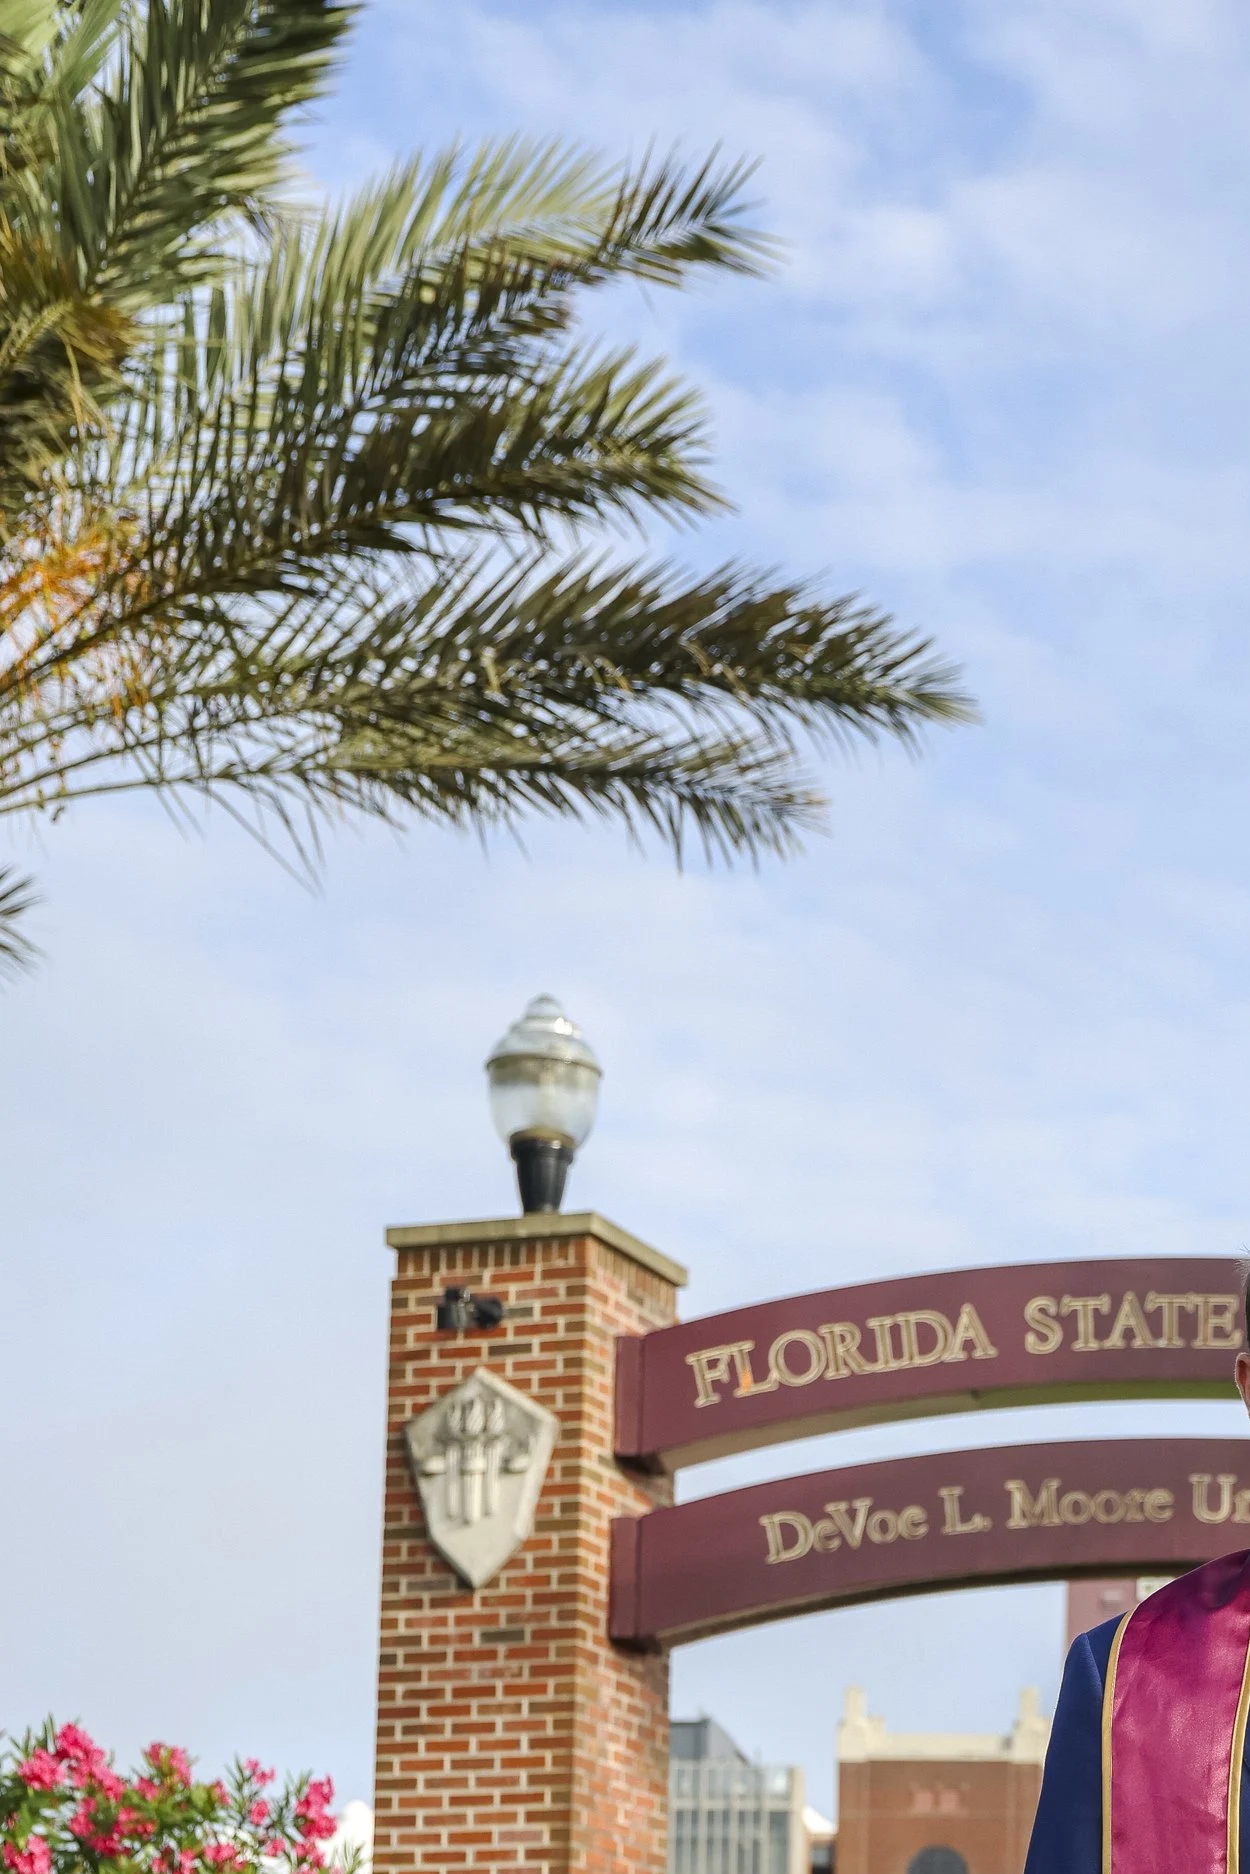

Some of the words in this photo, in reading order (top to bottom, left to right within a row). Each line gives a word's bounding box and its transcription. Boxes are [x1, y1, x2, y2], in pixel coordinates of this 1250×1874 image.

[685, 1302, 999, 1408] FLORIDA
[1023, 1290, 1244, 1354] STATE
[758, 1496, 929, 1565] DeVoe
[937, 1485, 993, 1536] L.
[1003, 1477, 1175, 1529] Moore
